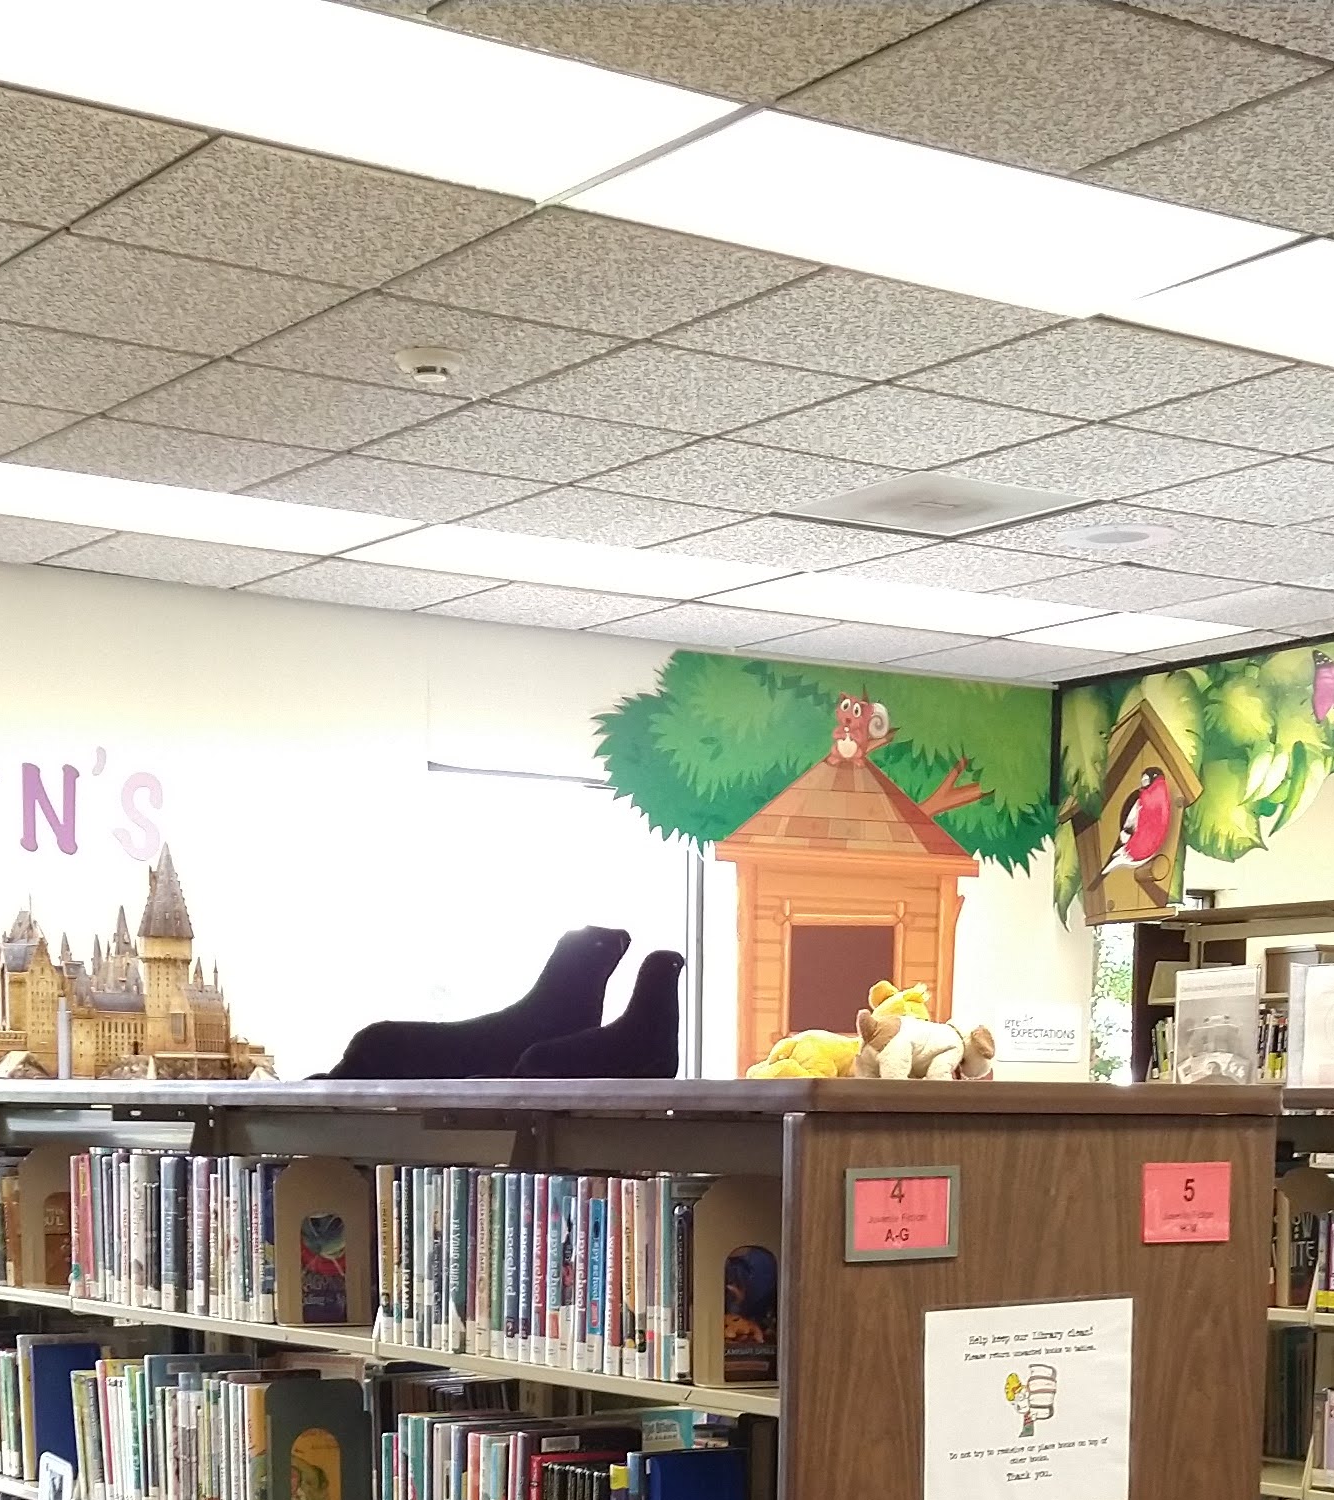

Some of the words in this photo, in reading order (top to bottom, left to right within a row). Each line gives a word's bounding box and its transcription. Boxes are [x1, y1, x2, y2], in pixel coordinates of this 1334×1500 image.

[1010, 1028, 1075, 1039] EXPECTATIONS
[890, 1179, 905, 1204] 4
[1184, 1178, 1196, 1202] 5
[885, 1228, 910, 1242] A-G
[506, 1226, 517, 1297] poached
[533, 1253, 544, 1308] school
[551, 1257, 561, 1310] school
[576, 1261, 586, 1312] school
